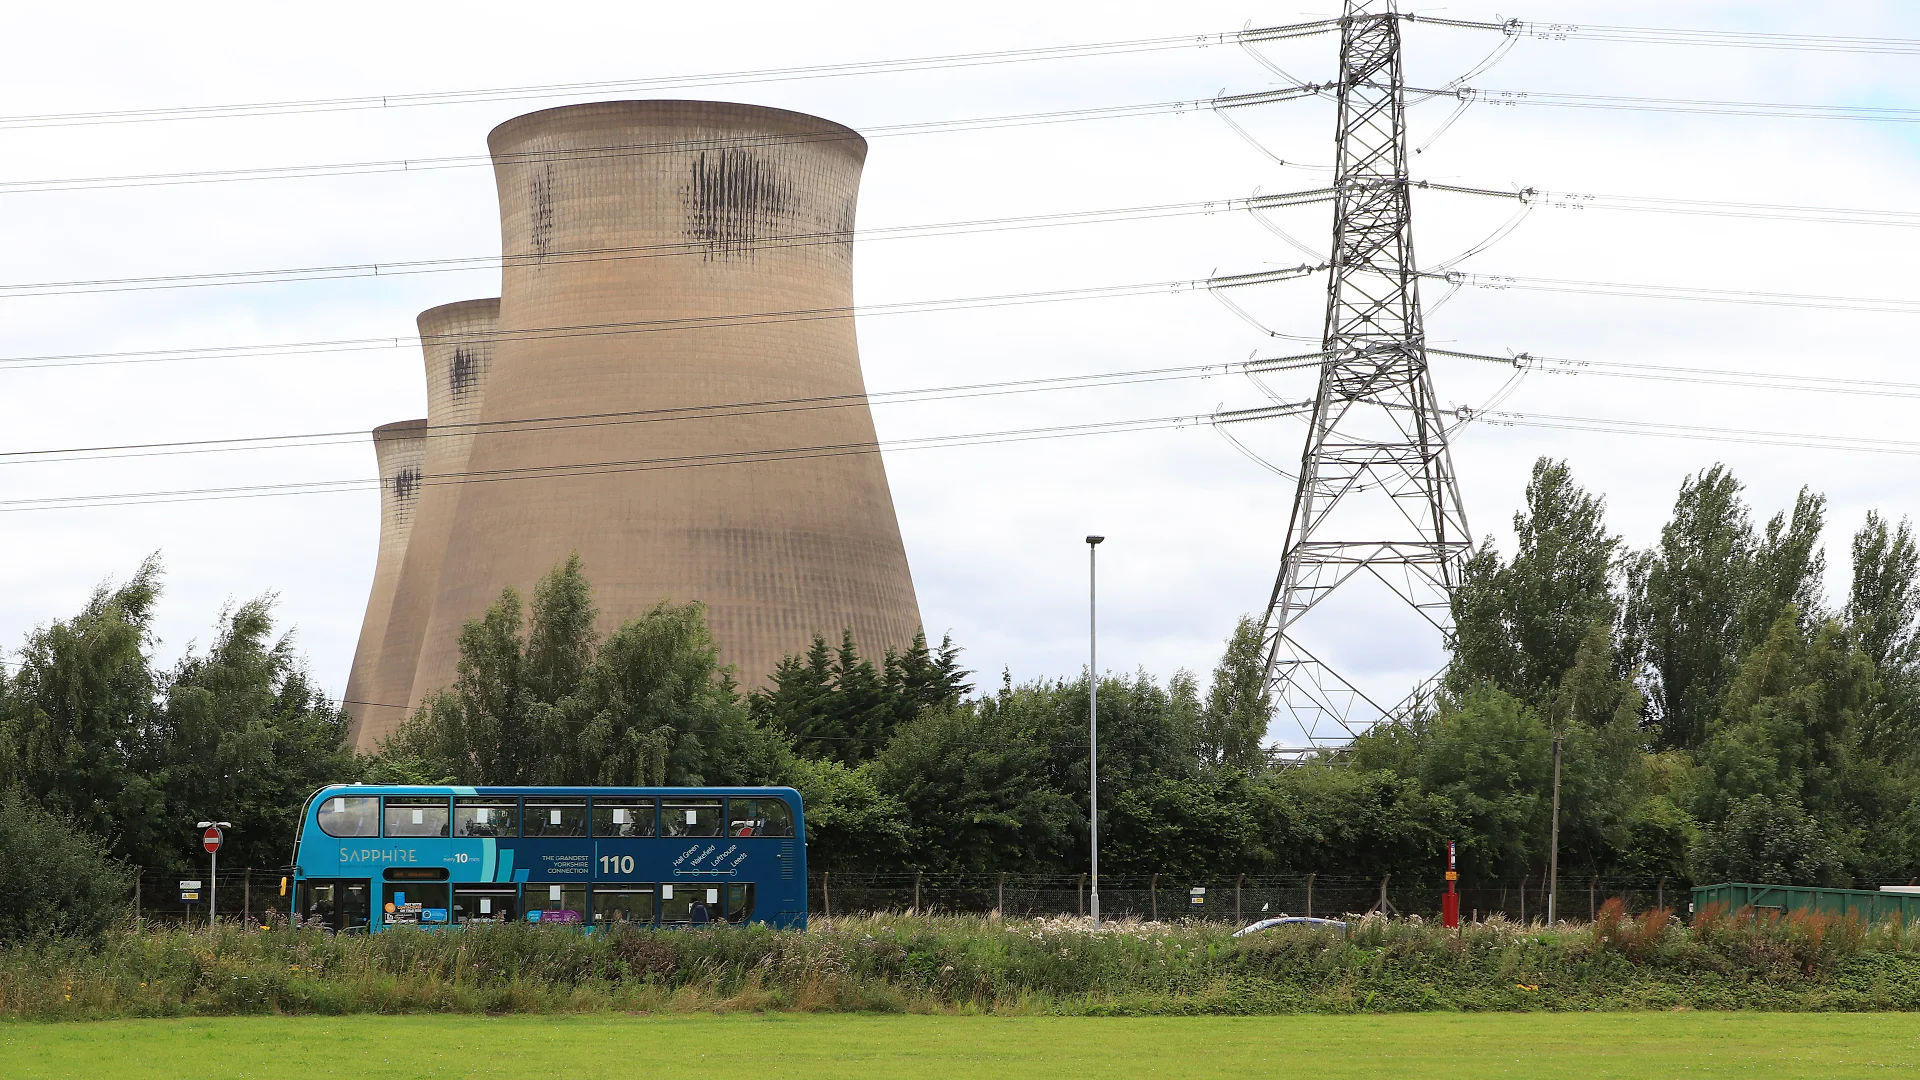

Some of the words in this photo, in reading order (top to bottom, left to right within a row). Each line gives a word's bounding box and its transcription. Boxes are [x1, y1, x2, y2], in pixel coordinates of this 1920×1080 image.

[339, 847, 418, 862] SAPPHIRE
[454, 853, 468, 863] 10
[672, 856, 685, 867] Hall
[682, 844, 700, 859] Green
[690, 844, 716, 867] Wakefield
[710, 844, 737, 867] Lofthouse
[730, 852, 748, 867] Leeds
[599, 855, 635, 874] 110
